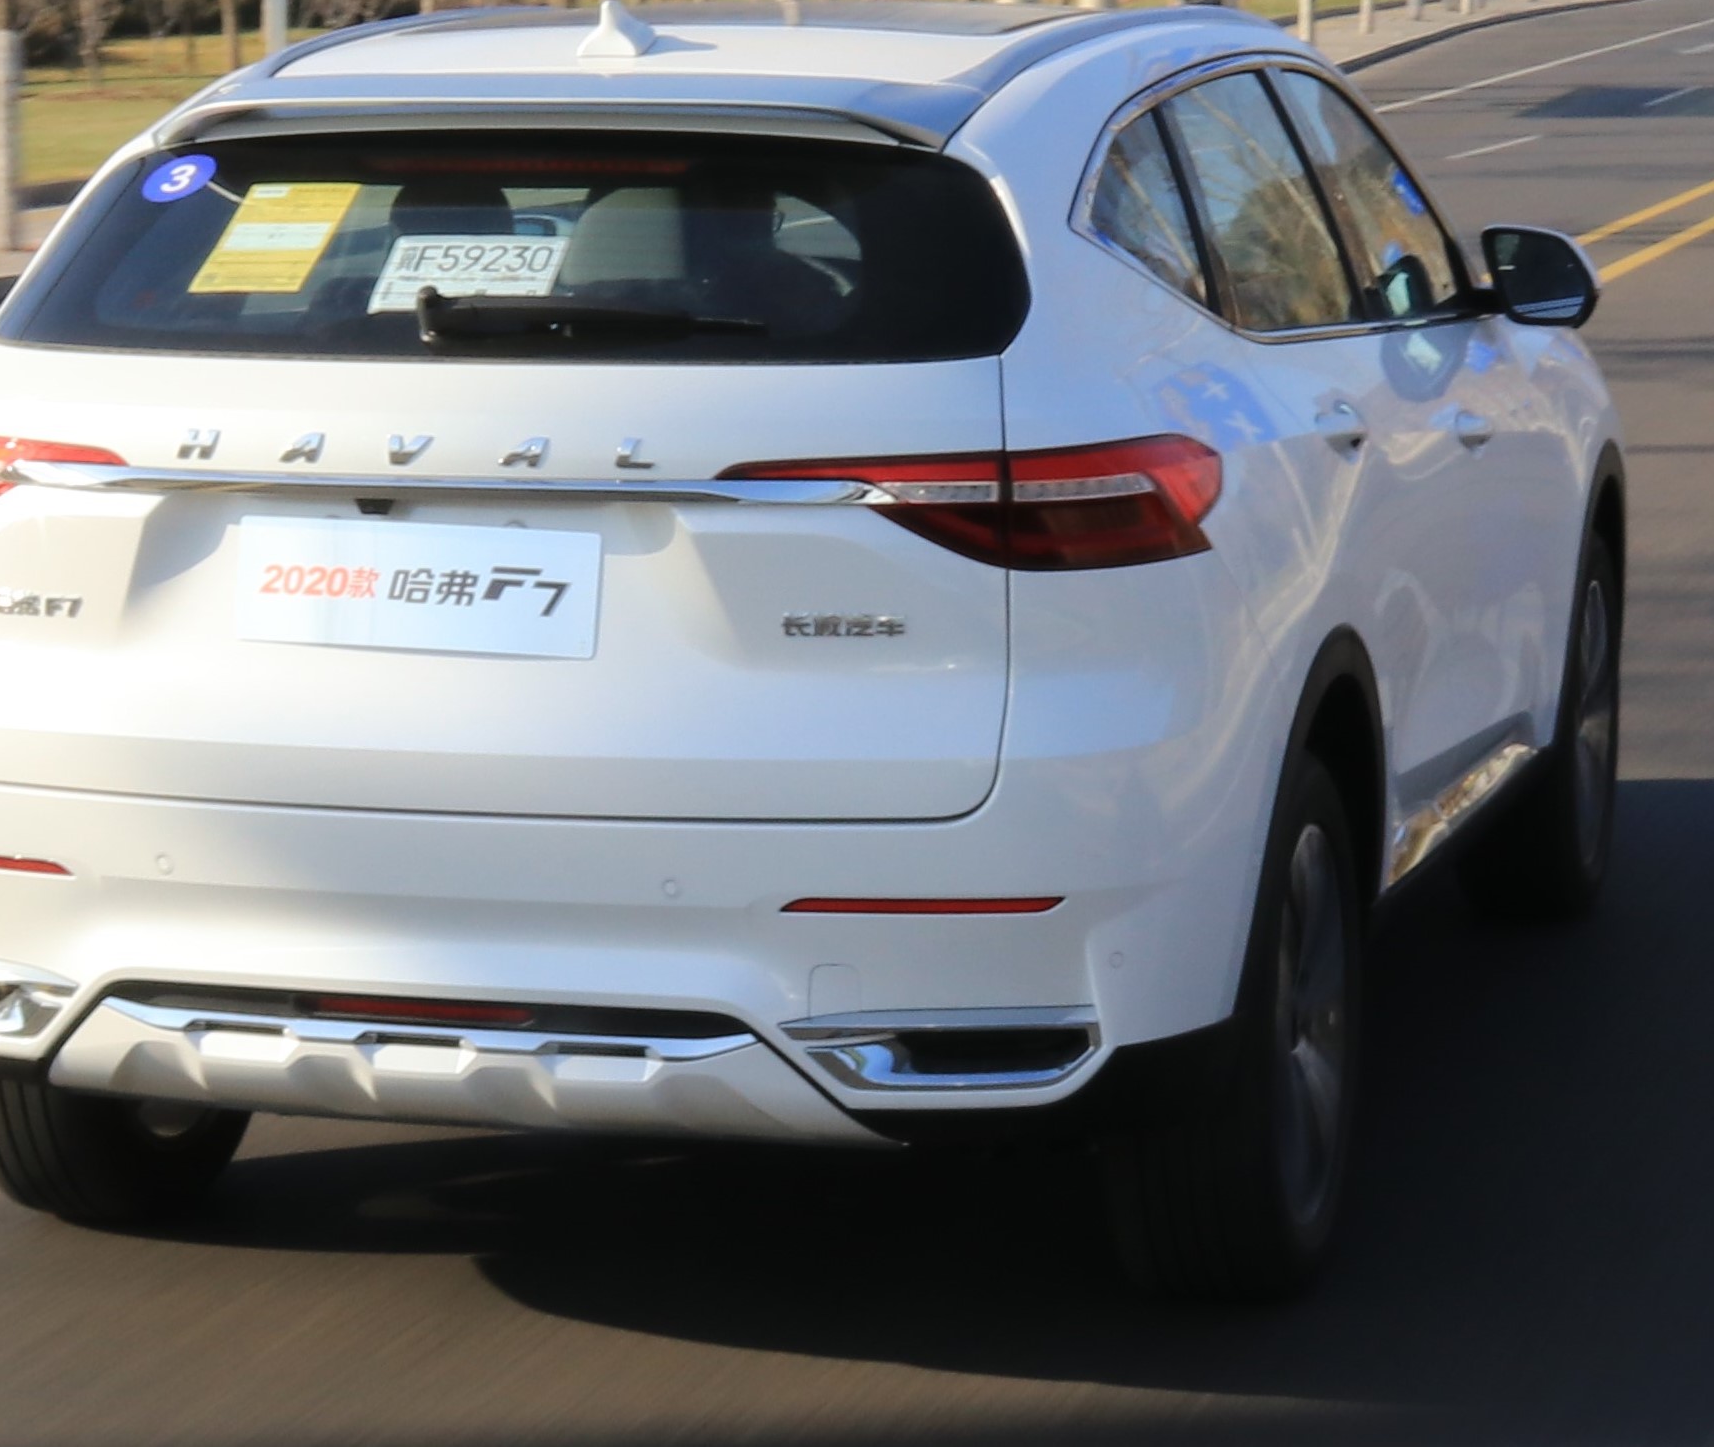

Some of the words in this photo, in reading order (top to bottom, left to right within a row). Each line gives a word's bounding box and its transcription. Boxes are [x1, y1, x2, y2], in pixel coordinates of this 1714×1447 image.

[159, 163, 198, 193] 3
[176, 428, 657, 470] HAVAL
[259, 563, 382, 599] 2020款
